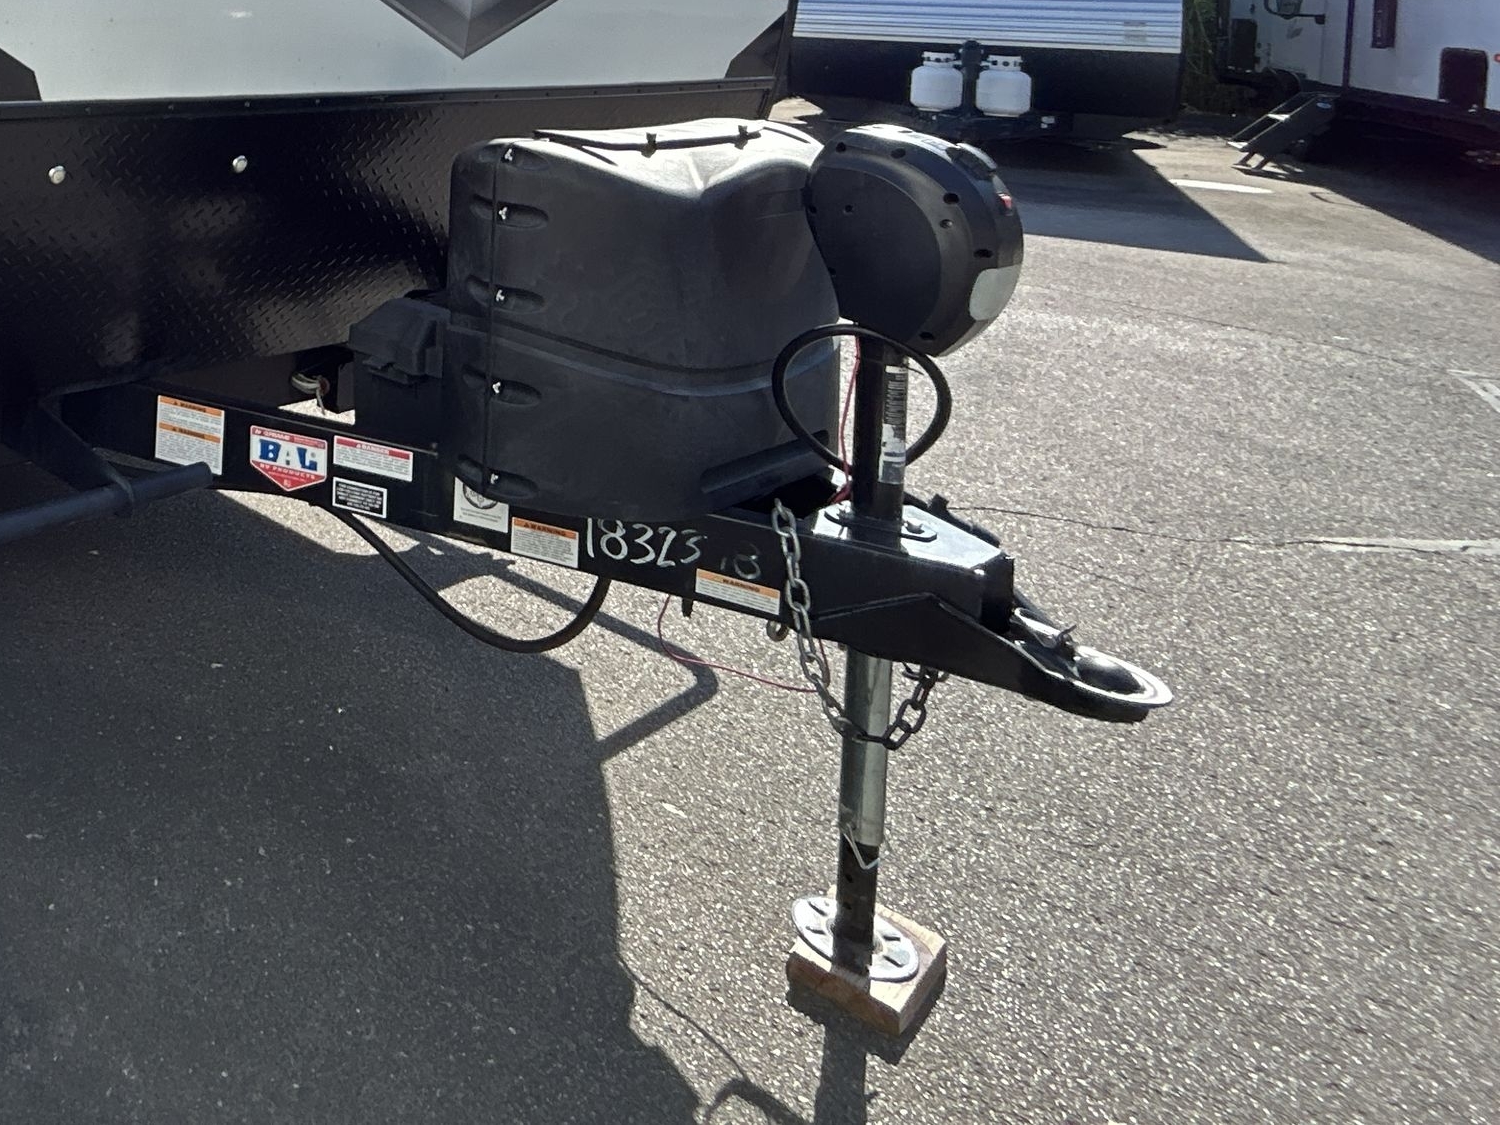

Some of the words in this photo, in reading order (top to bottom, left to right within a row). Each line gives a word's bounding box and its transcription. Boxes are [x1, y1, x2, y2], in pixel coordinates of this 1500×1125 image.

[259, 439, 318, 472] BAL
[530, 522, 567, 537] WARNING
[722, 577, 760, 593] WARNING
